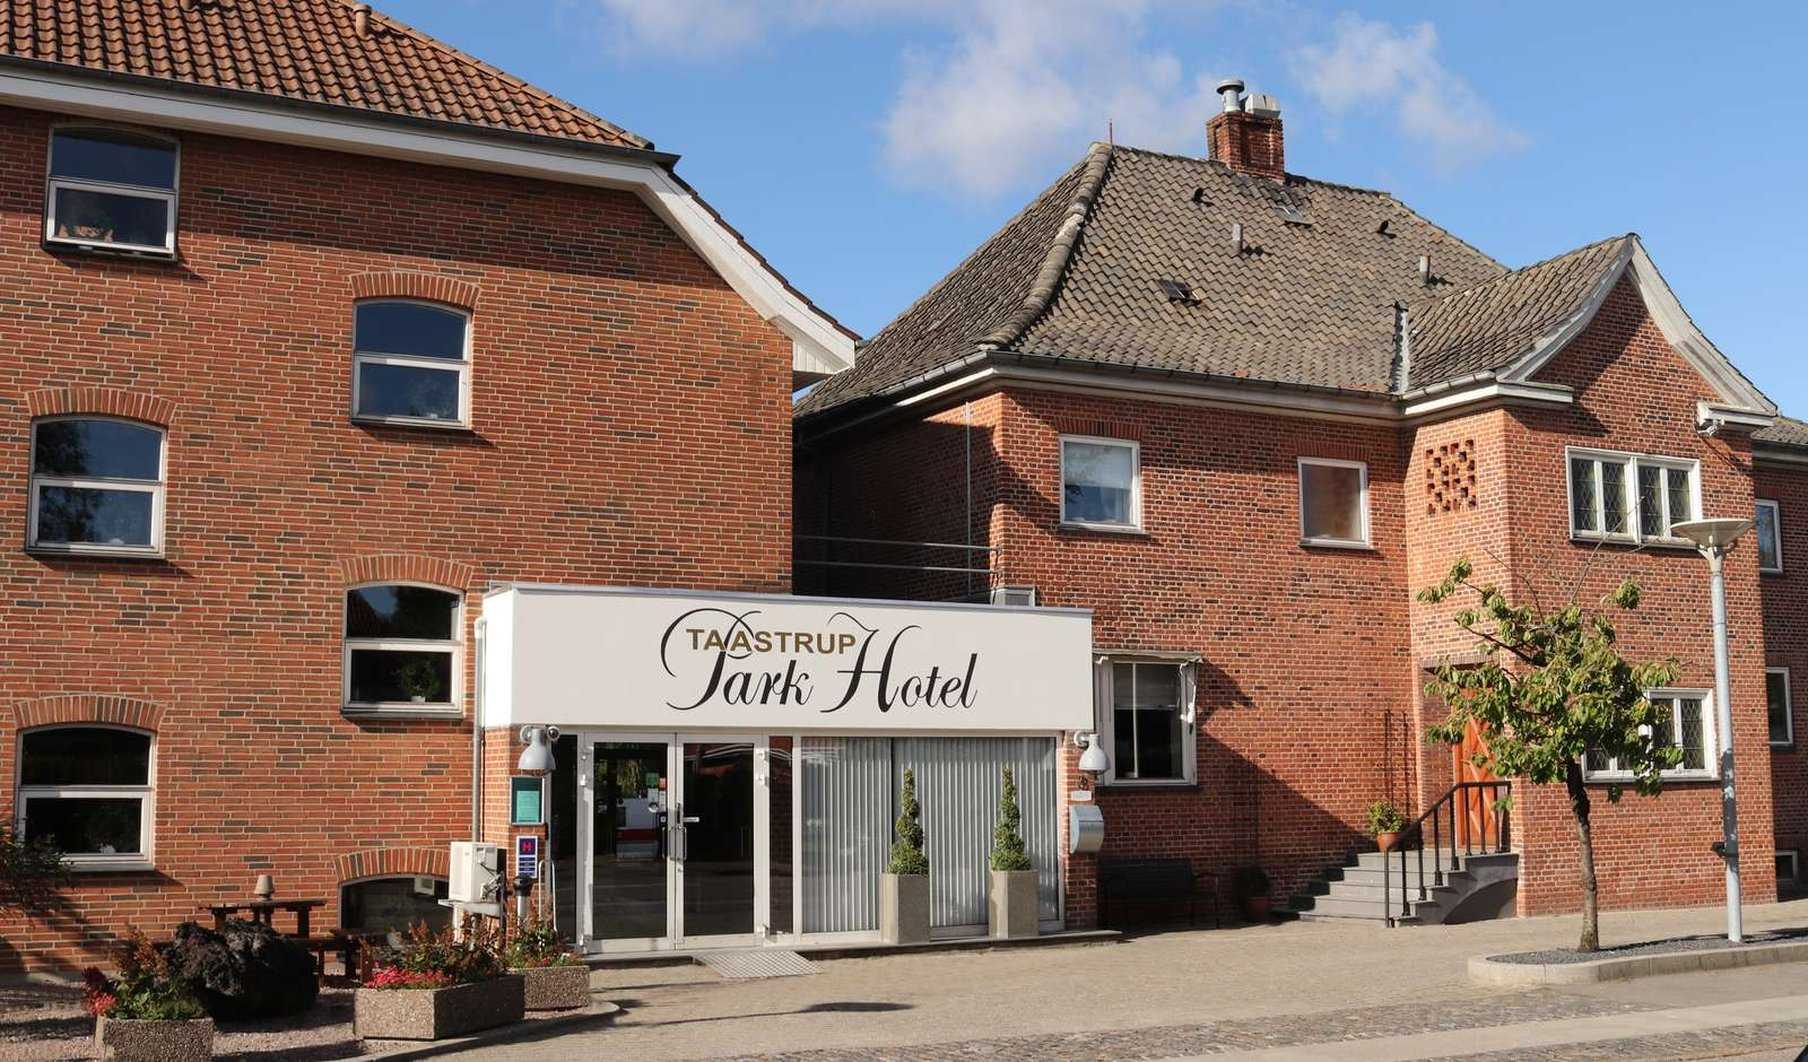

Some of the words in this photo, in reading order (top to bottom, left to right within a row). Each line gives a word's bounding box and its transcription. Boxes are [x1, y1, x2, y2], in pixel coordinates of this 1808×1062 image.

[660, 607, 815, 711] Park
[819, 611, 978, 714] Hotel
[686, 628, 856, 655] TAASTRUP
